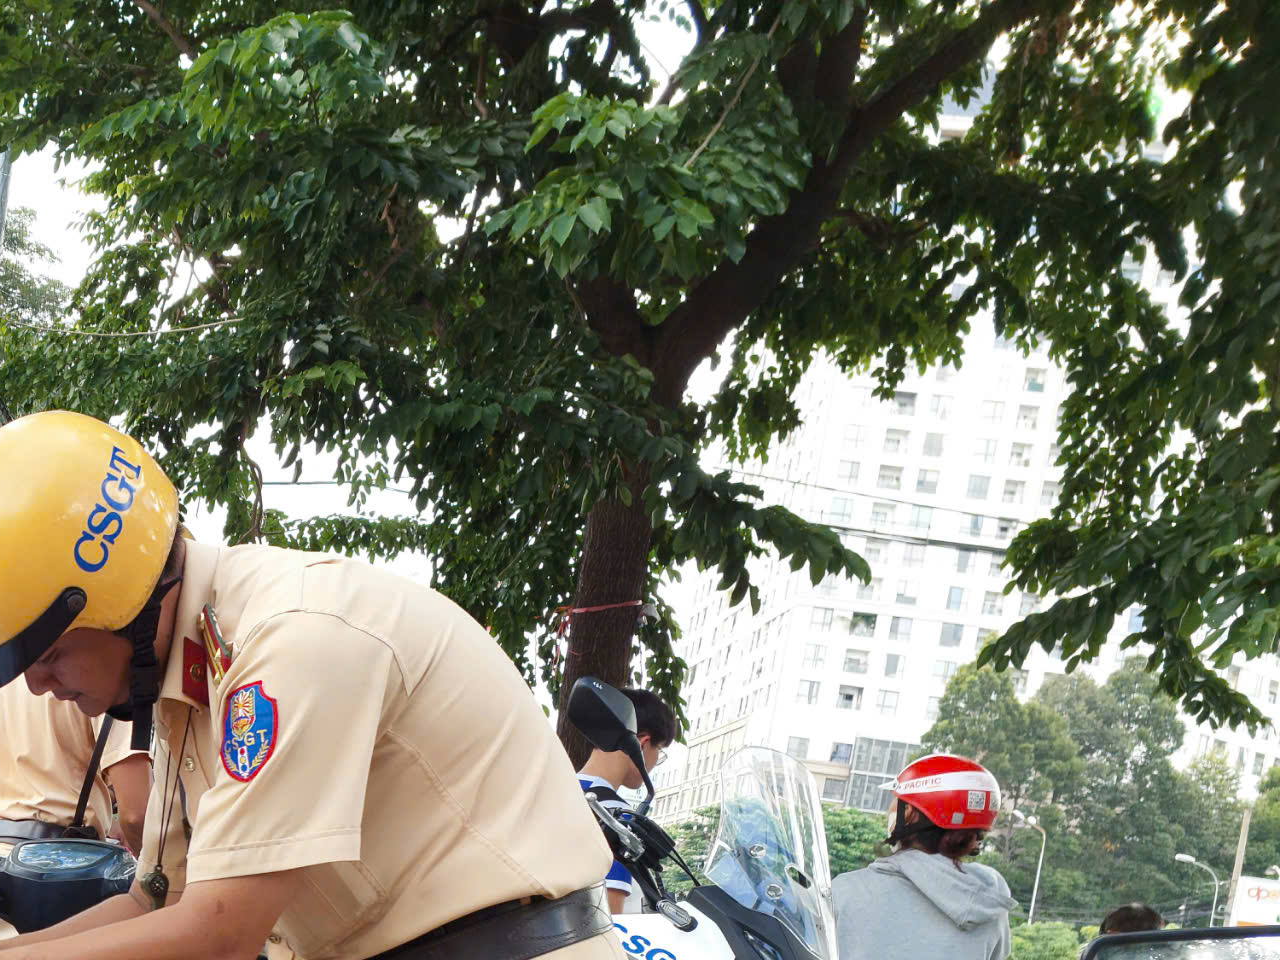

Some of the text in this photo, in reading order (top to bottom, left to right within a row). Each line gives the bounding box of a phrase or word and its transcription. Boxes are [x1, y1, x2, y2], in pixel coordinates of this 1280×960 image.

[73, 446, 142, 573] CSGT
[224, 729, 268, 754] CSGT
[904, 777, 942, 790] PACIFIC
